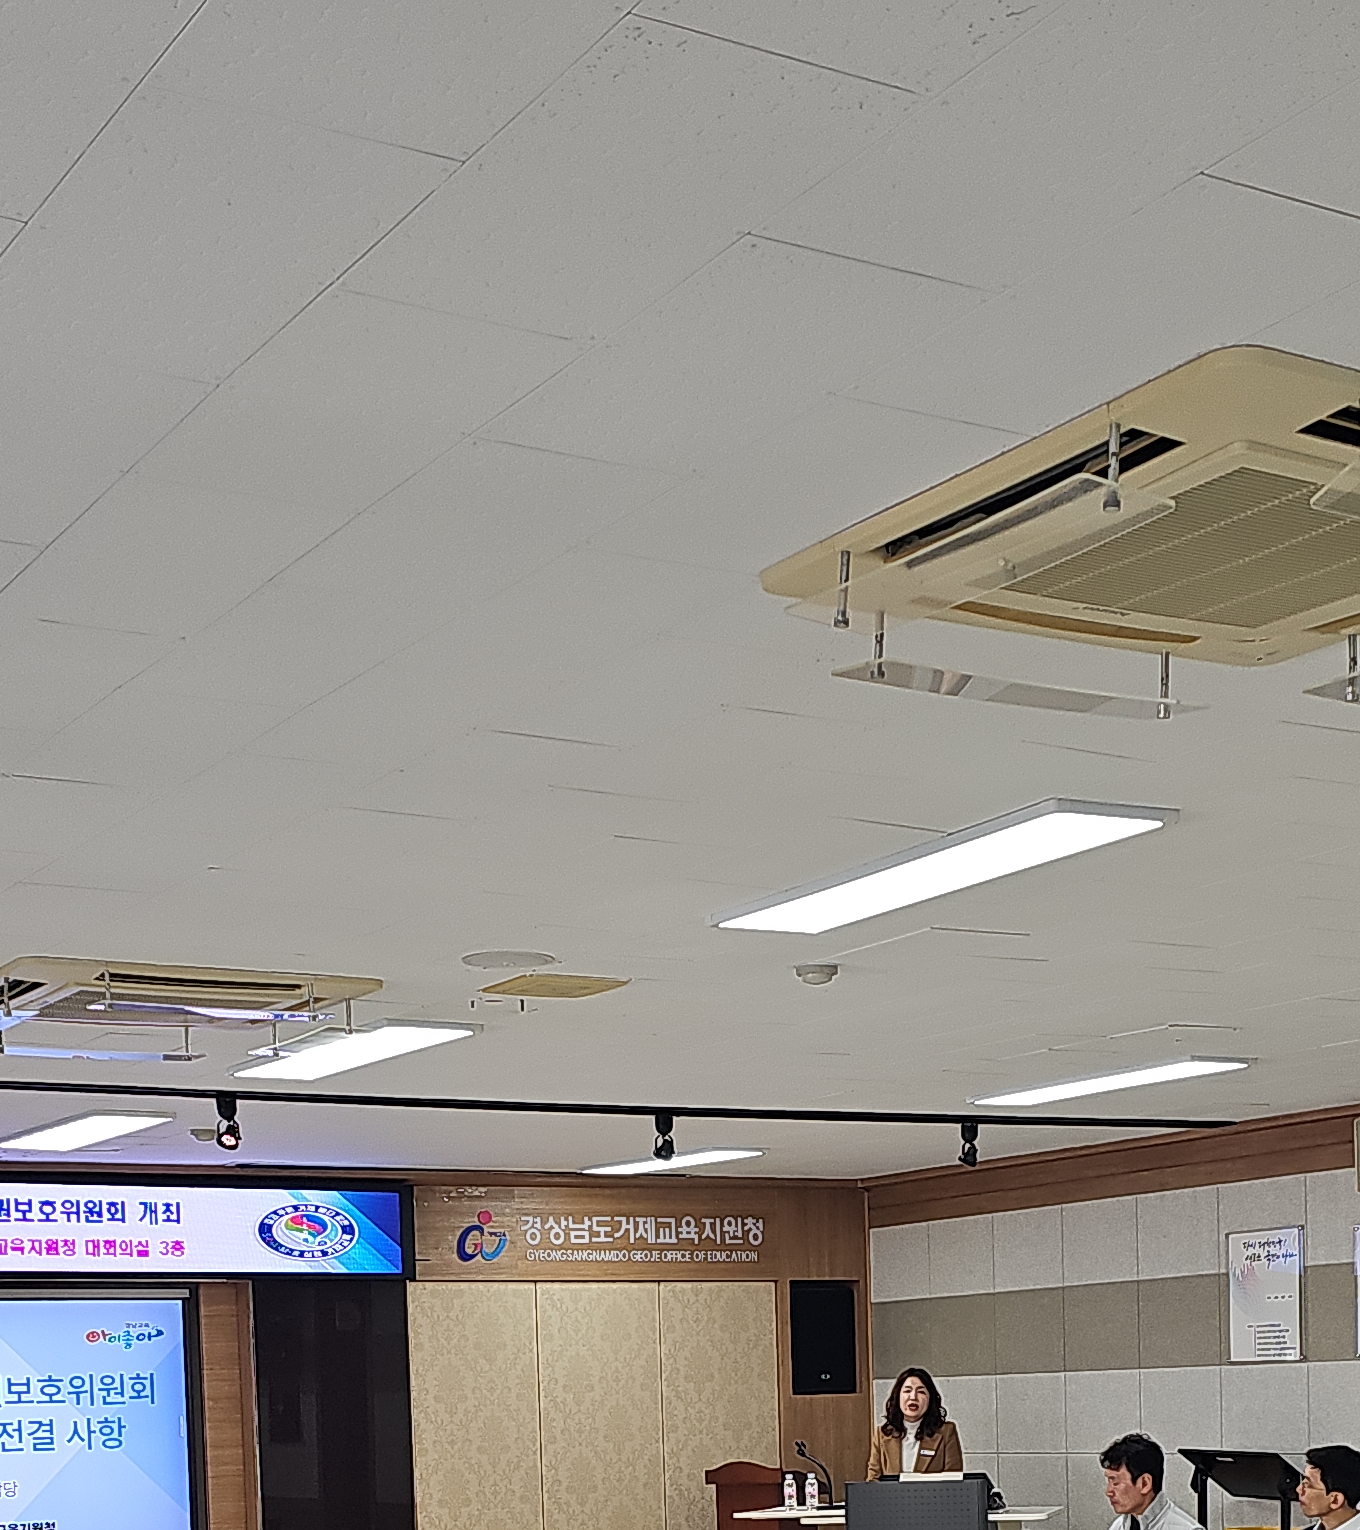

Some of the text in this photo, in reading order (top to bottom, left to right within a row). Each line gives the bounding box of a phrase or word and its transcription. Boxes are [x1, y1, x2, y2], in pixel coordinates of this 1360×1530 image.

[138, 1201, 181, 1225] 개최
[520, 1216, 764, 1246] 경상남도거제교육지원청
[85, 1239, 150, 1257] 대회의실
[159, 1240, 185, 1257] 3층
[526, 1250, 758, 1262] GYEONGSANGNAMDO GEOJE OFFICE OF EDUCATION
[66, 1415, 126, 1451] 사항
